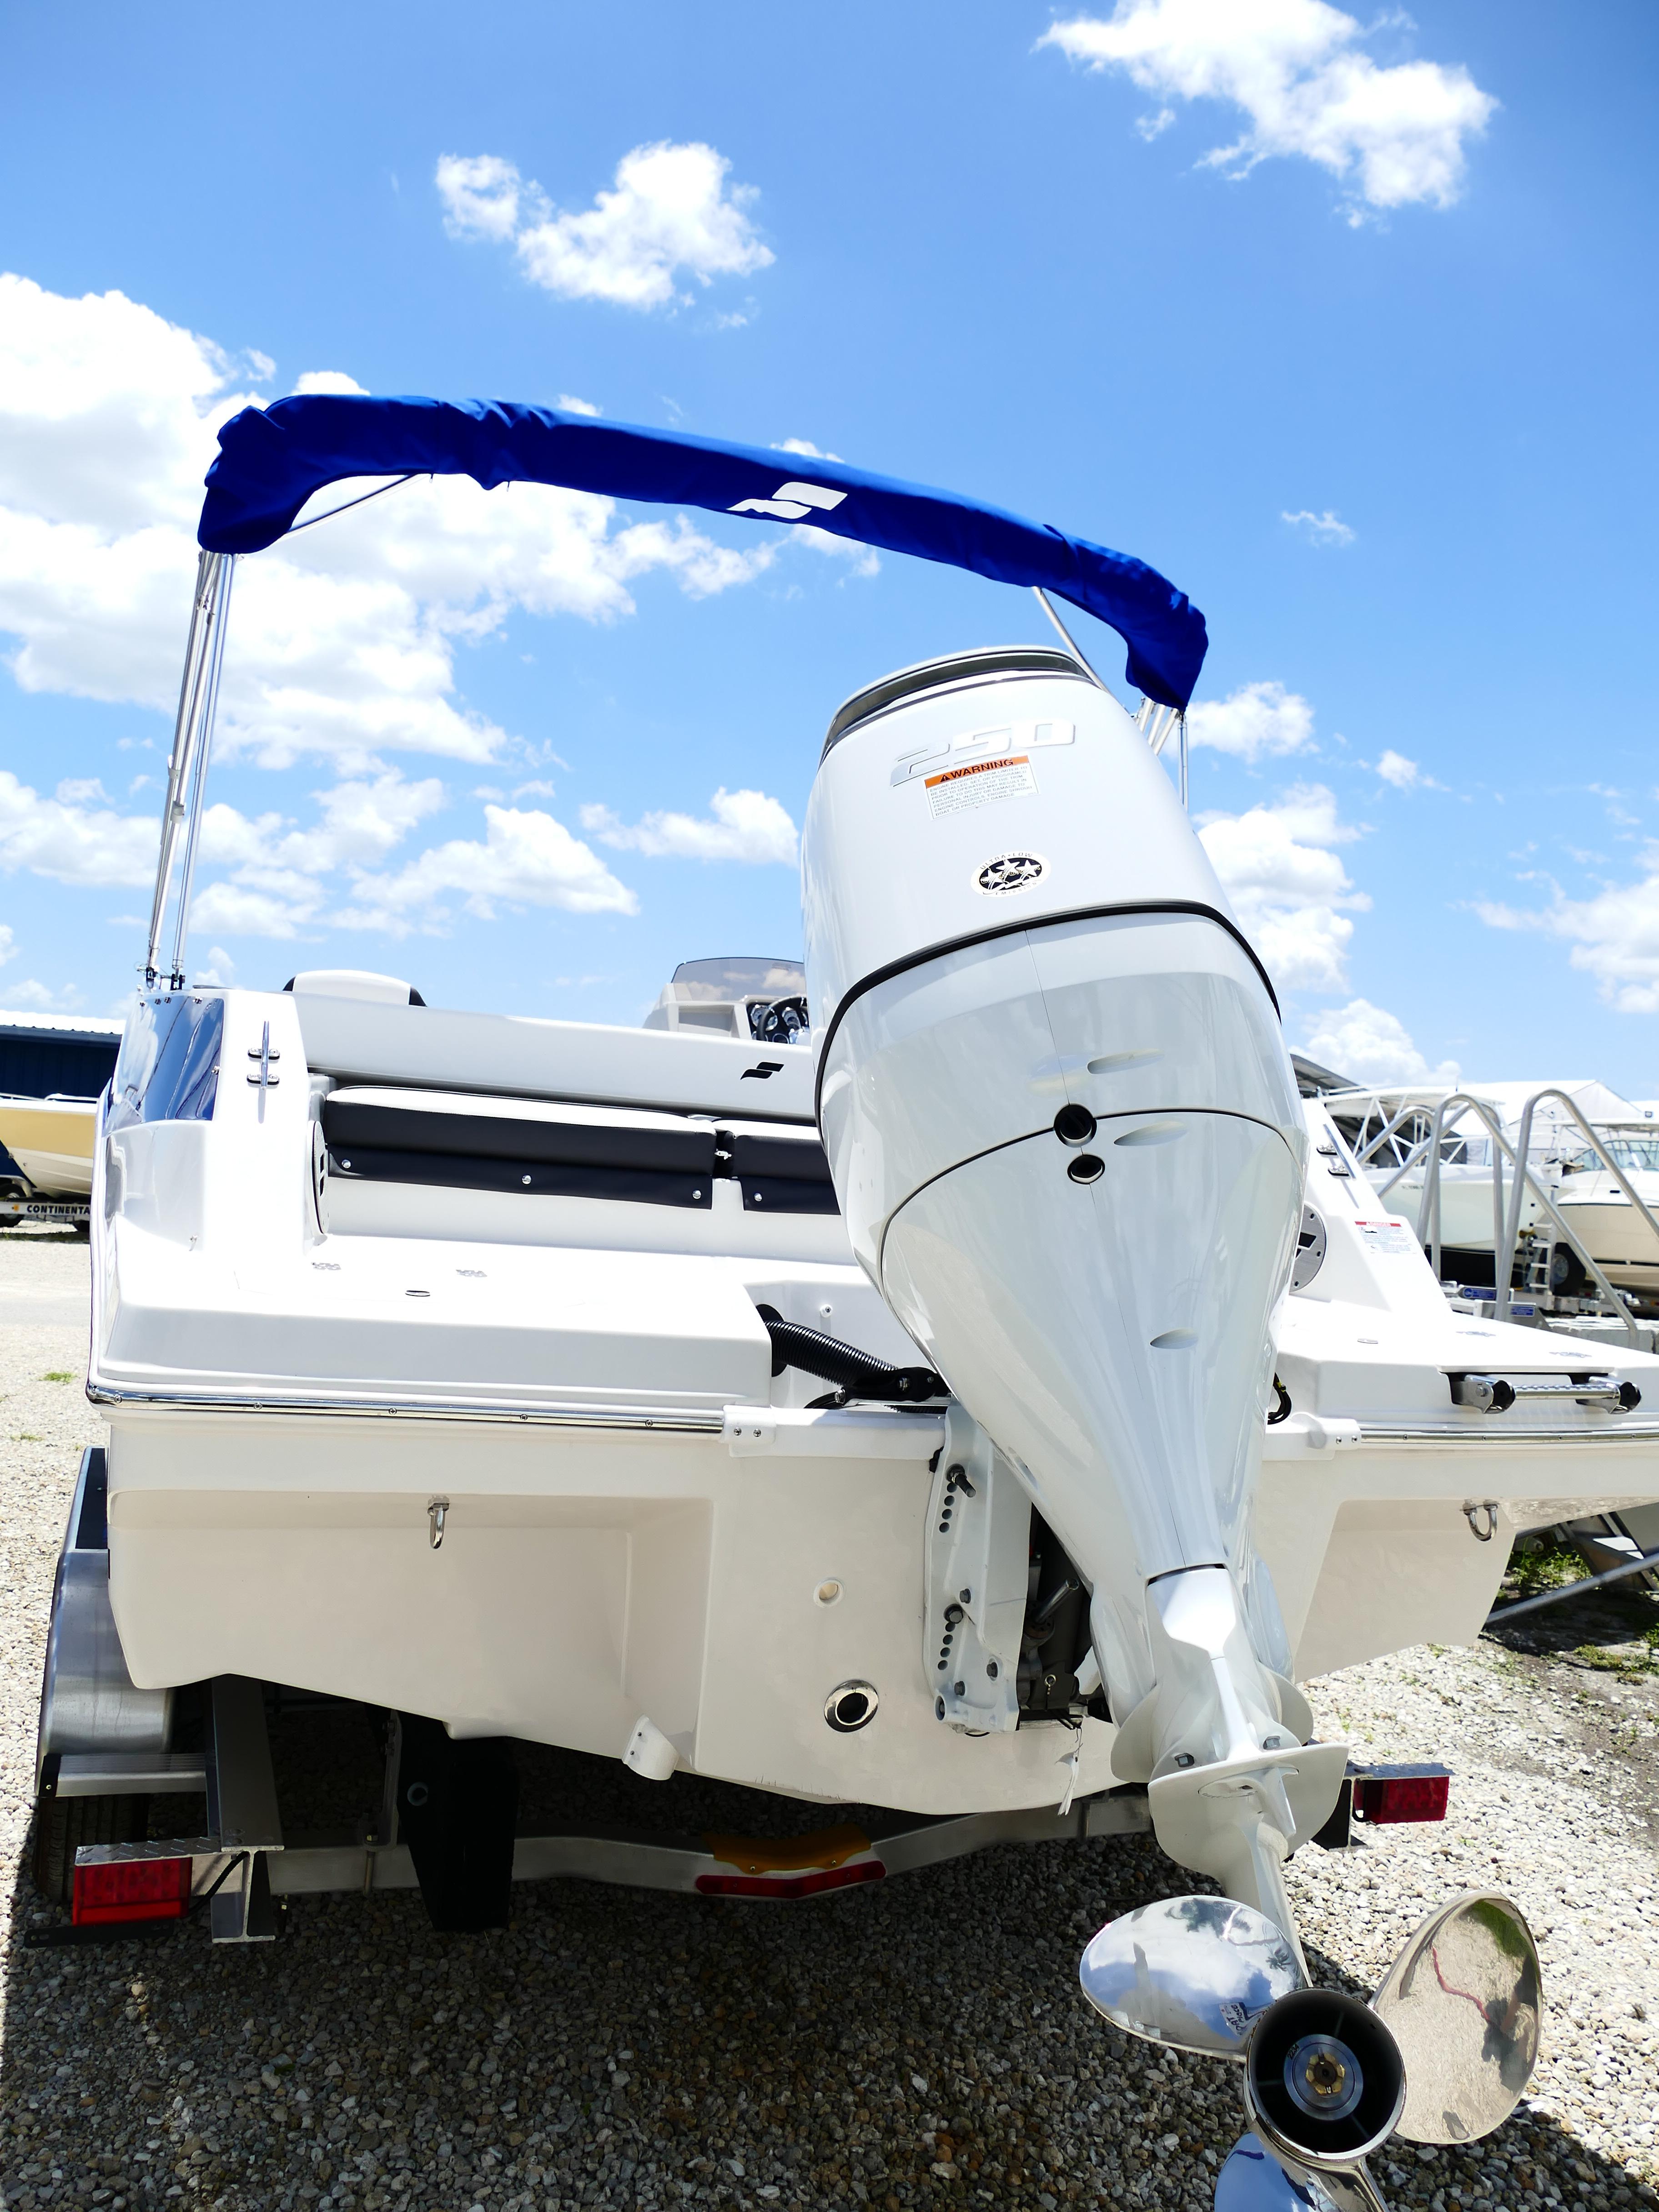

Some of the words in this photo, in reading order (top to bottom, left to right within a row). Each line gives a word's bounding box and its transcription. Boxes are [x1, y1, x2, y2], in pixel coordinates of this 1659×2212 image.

[890, 719, 1076, 788] 250
[950, 759, 1014, 778] WARNING
[930, 783, 949, 792] ENGINE
[950, 776, 977, 785] REQUIRES
[957, 781, 988, 792] OPERATION
[933, 794, 955, 804] FAILURE
[933, 797, 962, 808] PERSONAL
[961, 798, 990, 808] PROPERTY
[935, 803, 954, 812] ENGINE
